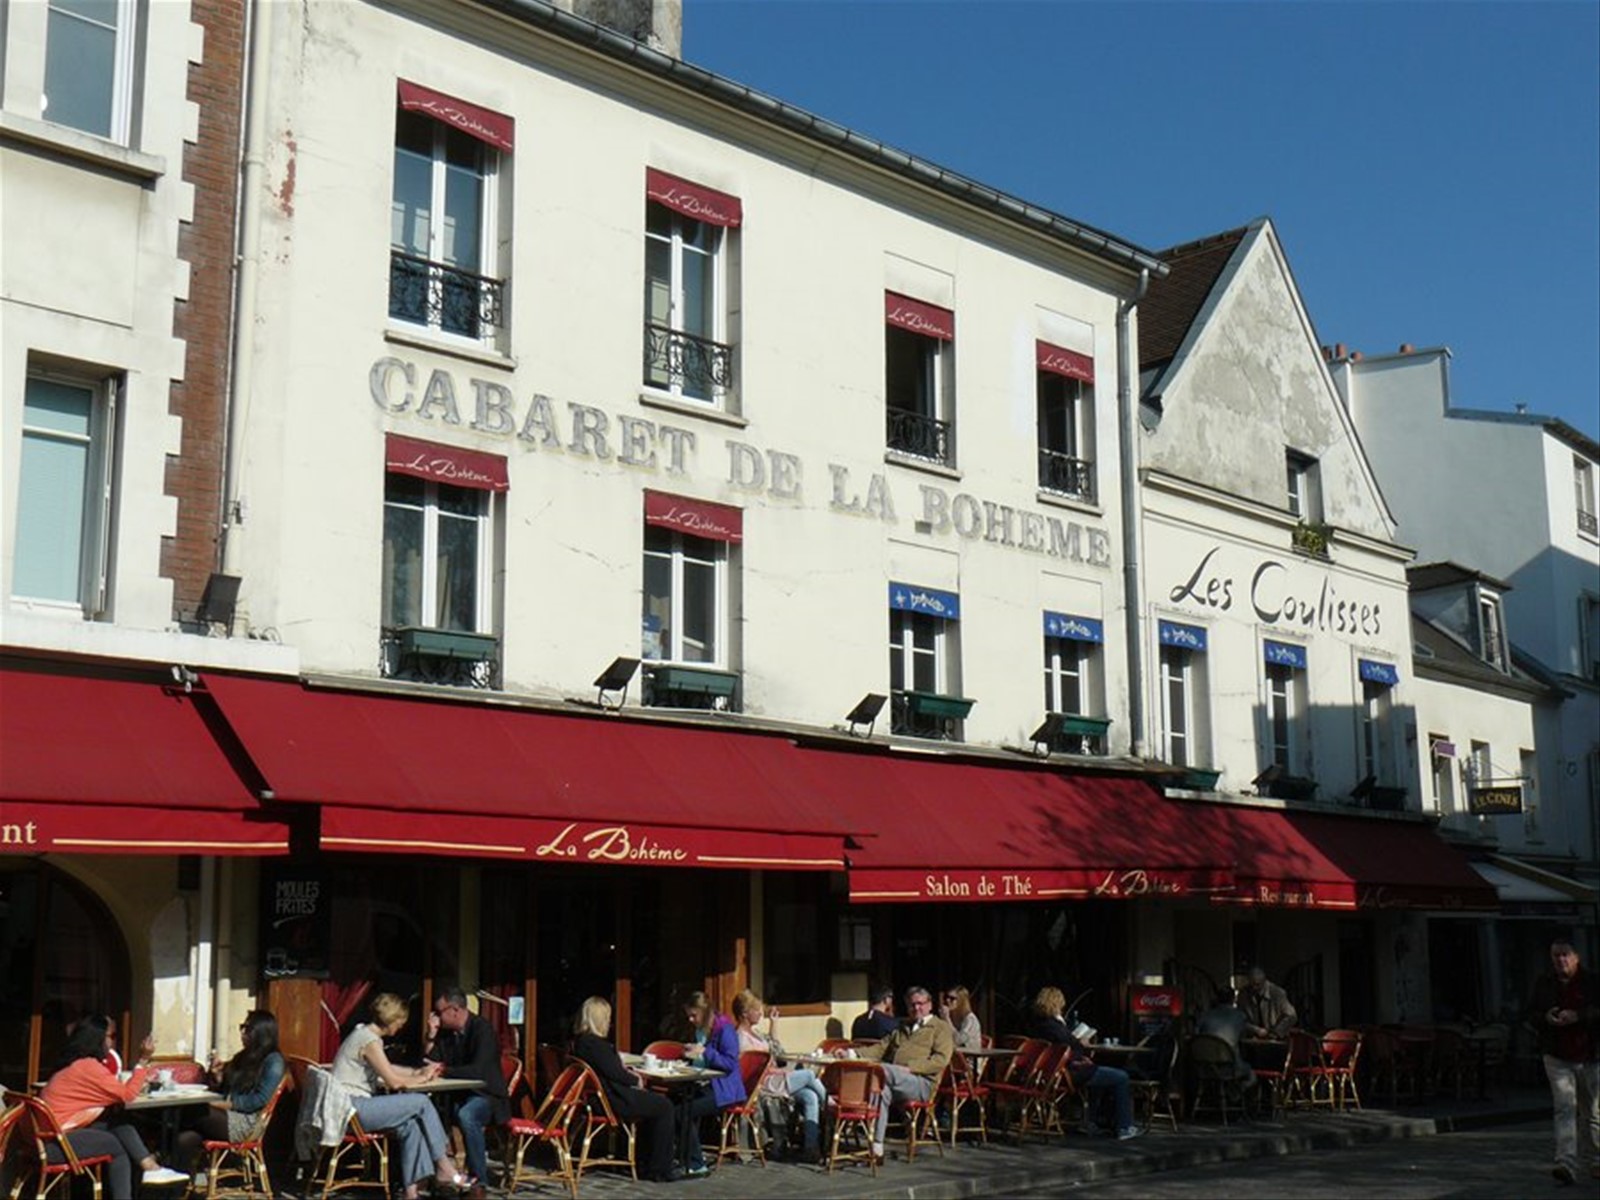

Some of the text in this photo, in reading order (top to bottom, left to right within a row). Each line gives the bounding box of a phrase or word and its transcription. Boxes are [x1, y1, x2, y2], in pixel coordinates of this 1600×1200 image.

[368, 356, 1112, 568] CABARET DE LA BOHEME
[1169, 547, 1381, 636] Les Coulisses
[536, 823, 687, 861] La Bohème
[275, 880, 321, 899] MOULES
[925, 875, 970, 897] Salon
[977, 875, 996, 896] de
[1002, 874, 1032, 896] Thé
[1094, 869, 1118, 896] La
